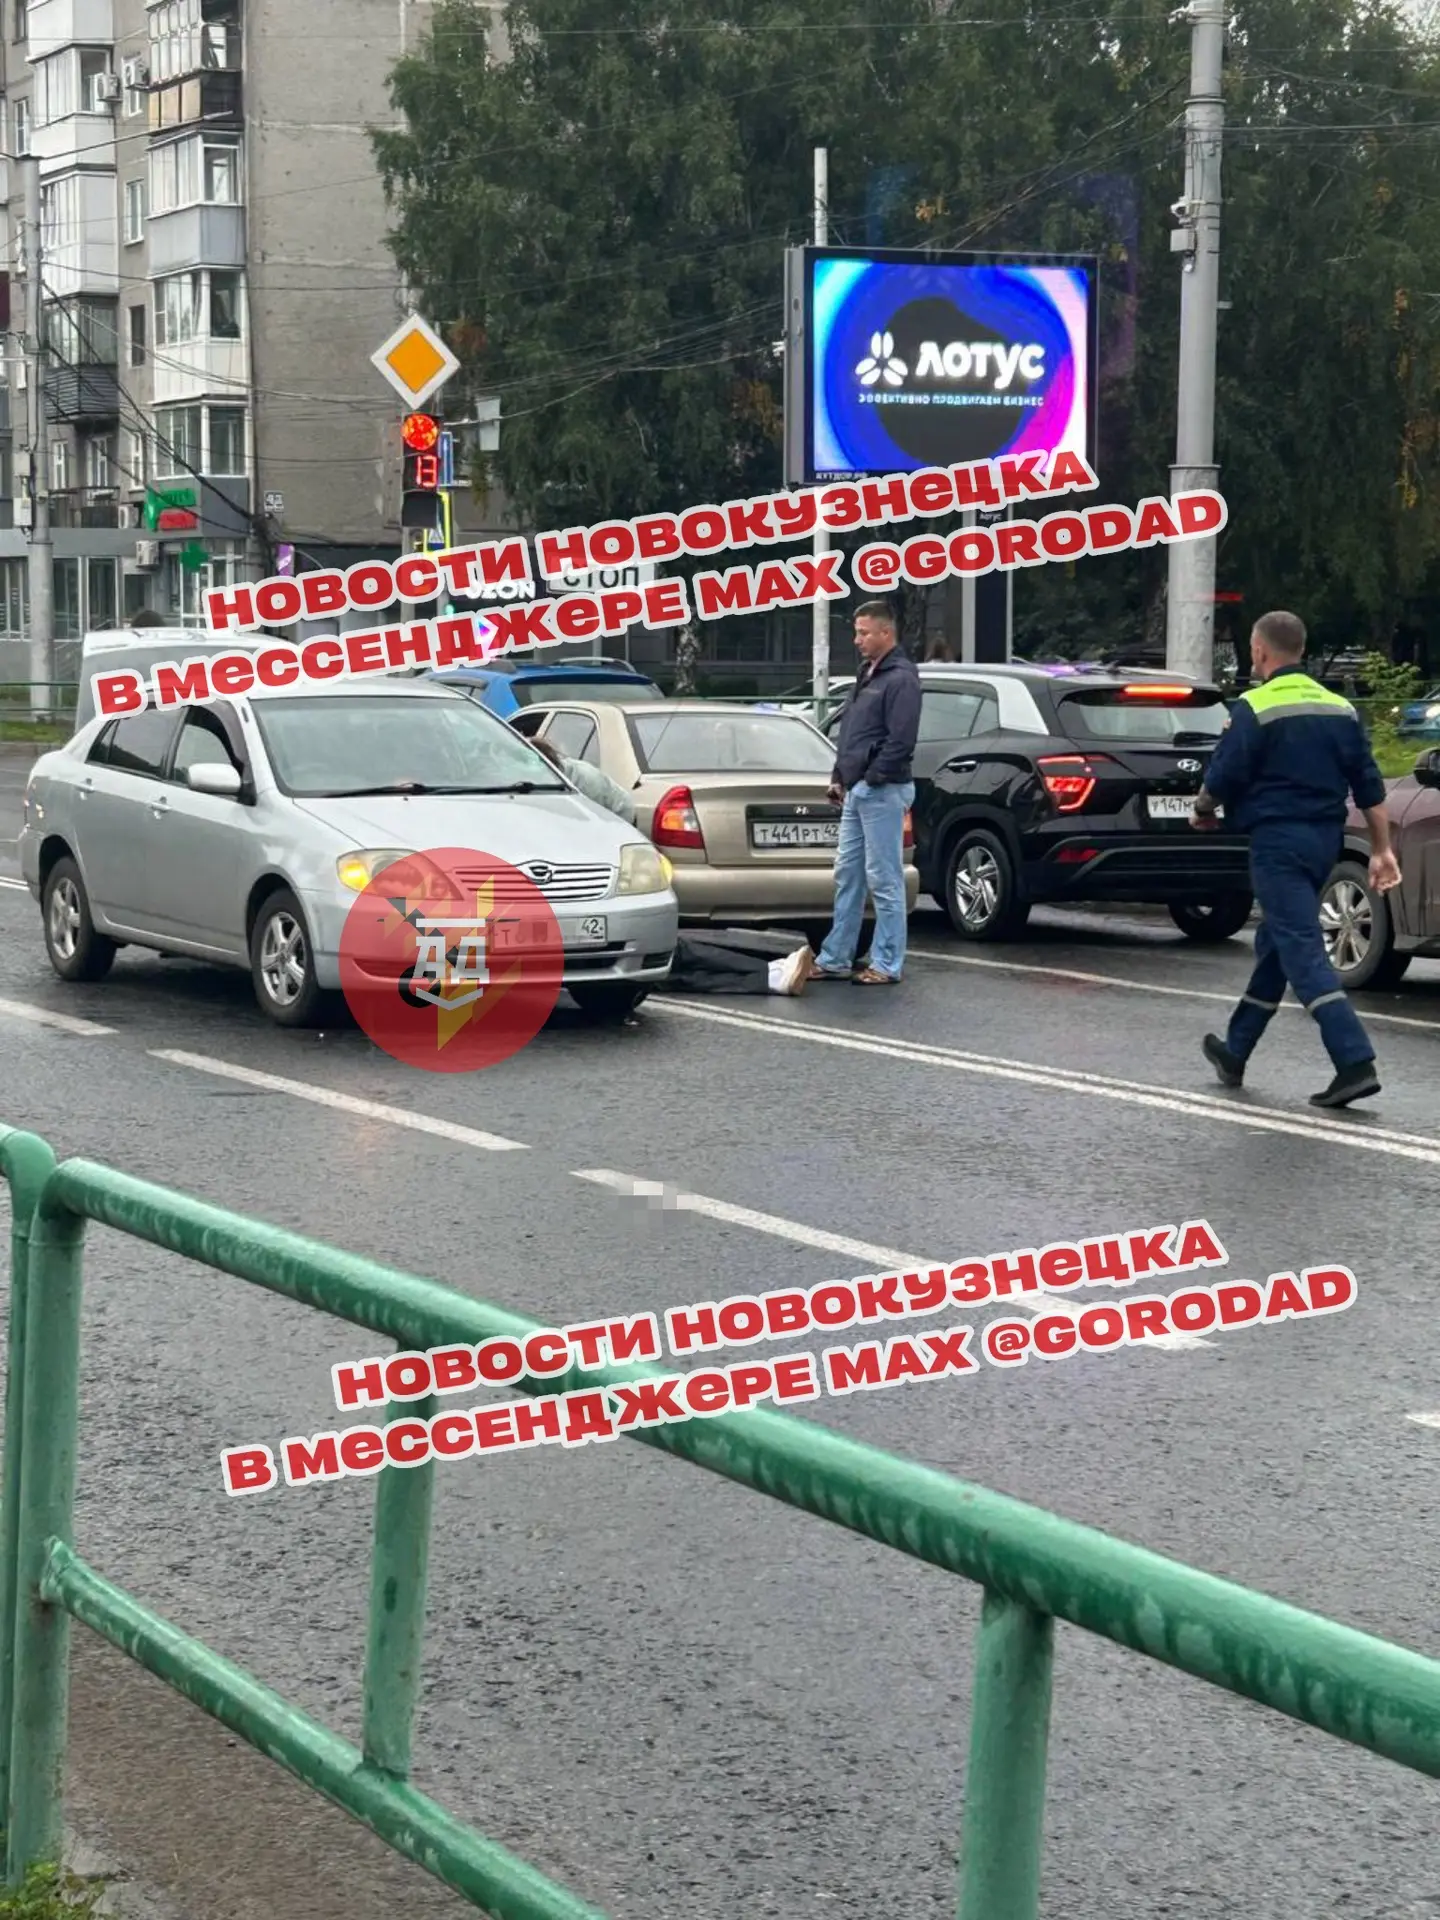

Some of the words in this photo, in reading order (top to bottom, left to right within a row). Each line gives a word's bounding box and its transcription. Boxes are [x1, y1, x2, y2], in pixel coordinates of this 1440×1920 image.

[1003, 396, 1045, 406] БИЗНЕС
[416, 455, 437, 487] 13
[581, 918, 598, 934] 42
